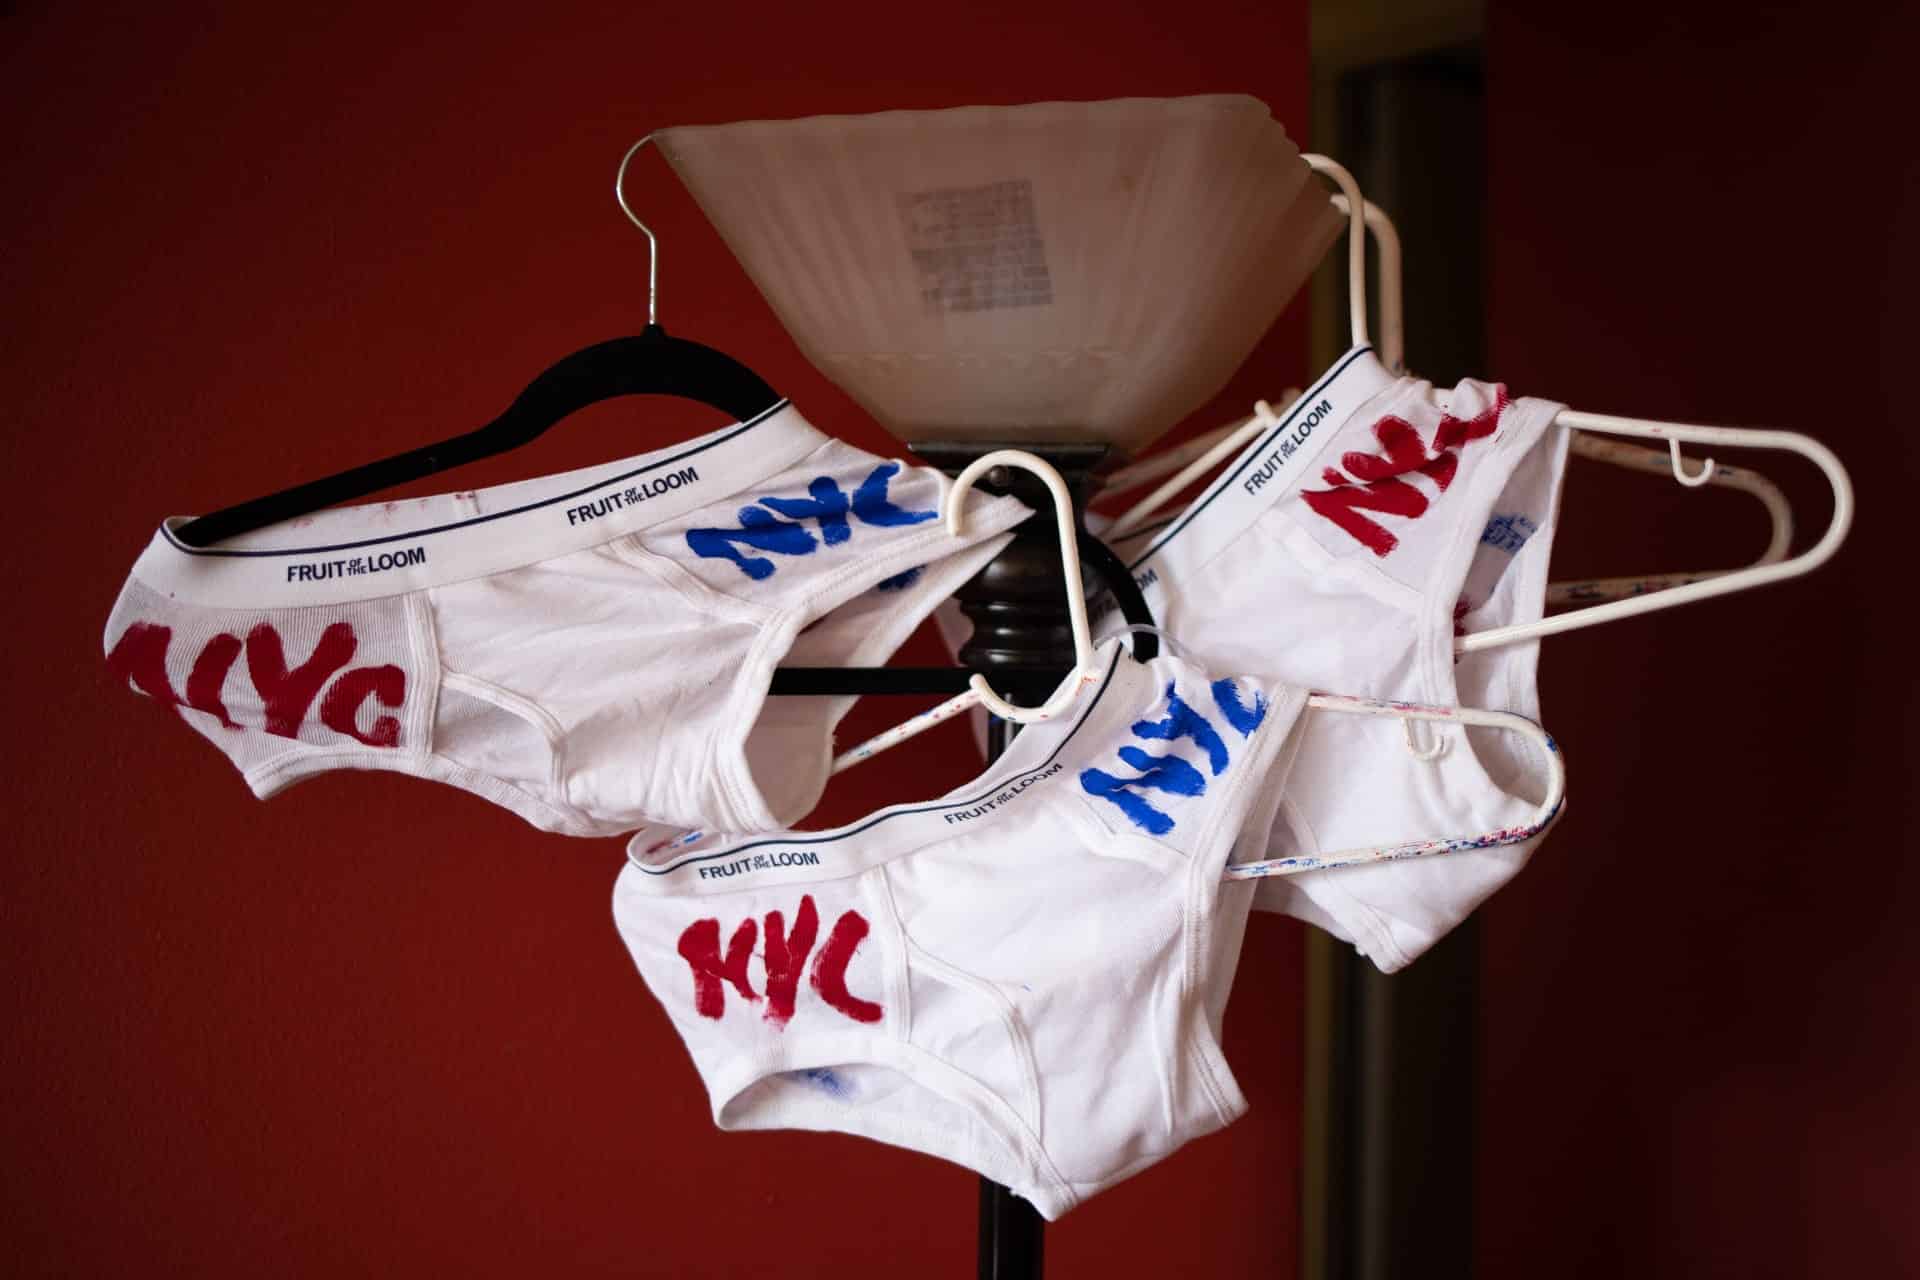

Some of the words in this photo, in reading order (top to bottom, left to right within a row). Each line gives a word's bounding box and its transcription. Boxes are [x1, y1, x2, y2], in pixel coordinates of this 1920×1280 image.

[1243, 450, 1284, 495] FRUIT
[1291, 399, 1333, 446] LOOM
[566, 493, 623, 526] FRUIT
[623, 487, 637, 498] OF
[641, 466, 699, 499] LOOM
[686, 462, 939, 581] NYC
[287, 560, 346, 582] FRUIT
[346, 565, 368, 576] THE
[348, 557, 363, 568] OF
[367, 546, 426, 573] LOOM
[1079, 677, 1269, 836] NYC
[944, 799, 997, 824] FRUIT
[1010, 763, 1063, 795] LOOM
[698, 858, 751, 880] FRUIT
[769, 852, 820, 867] LOOM
[677, 893, 884, 1032] NYC
